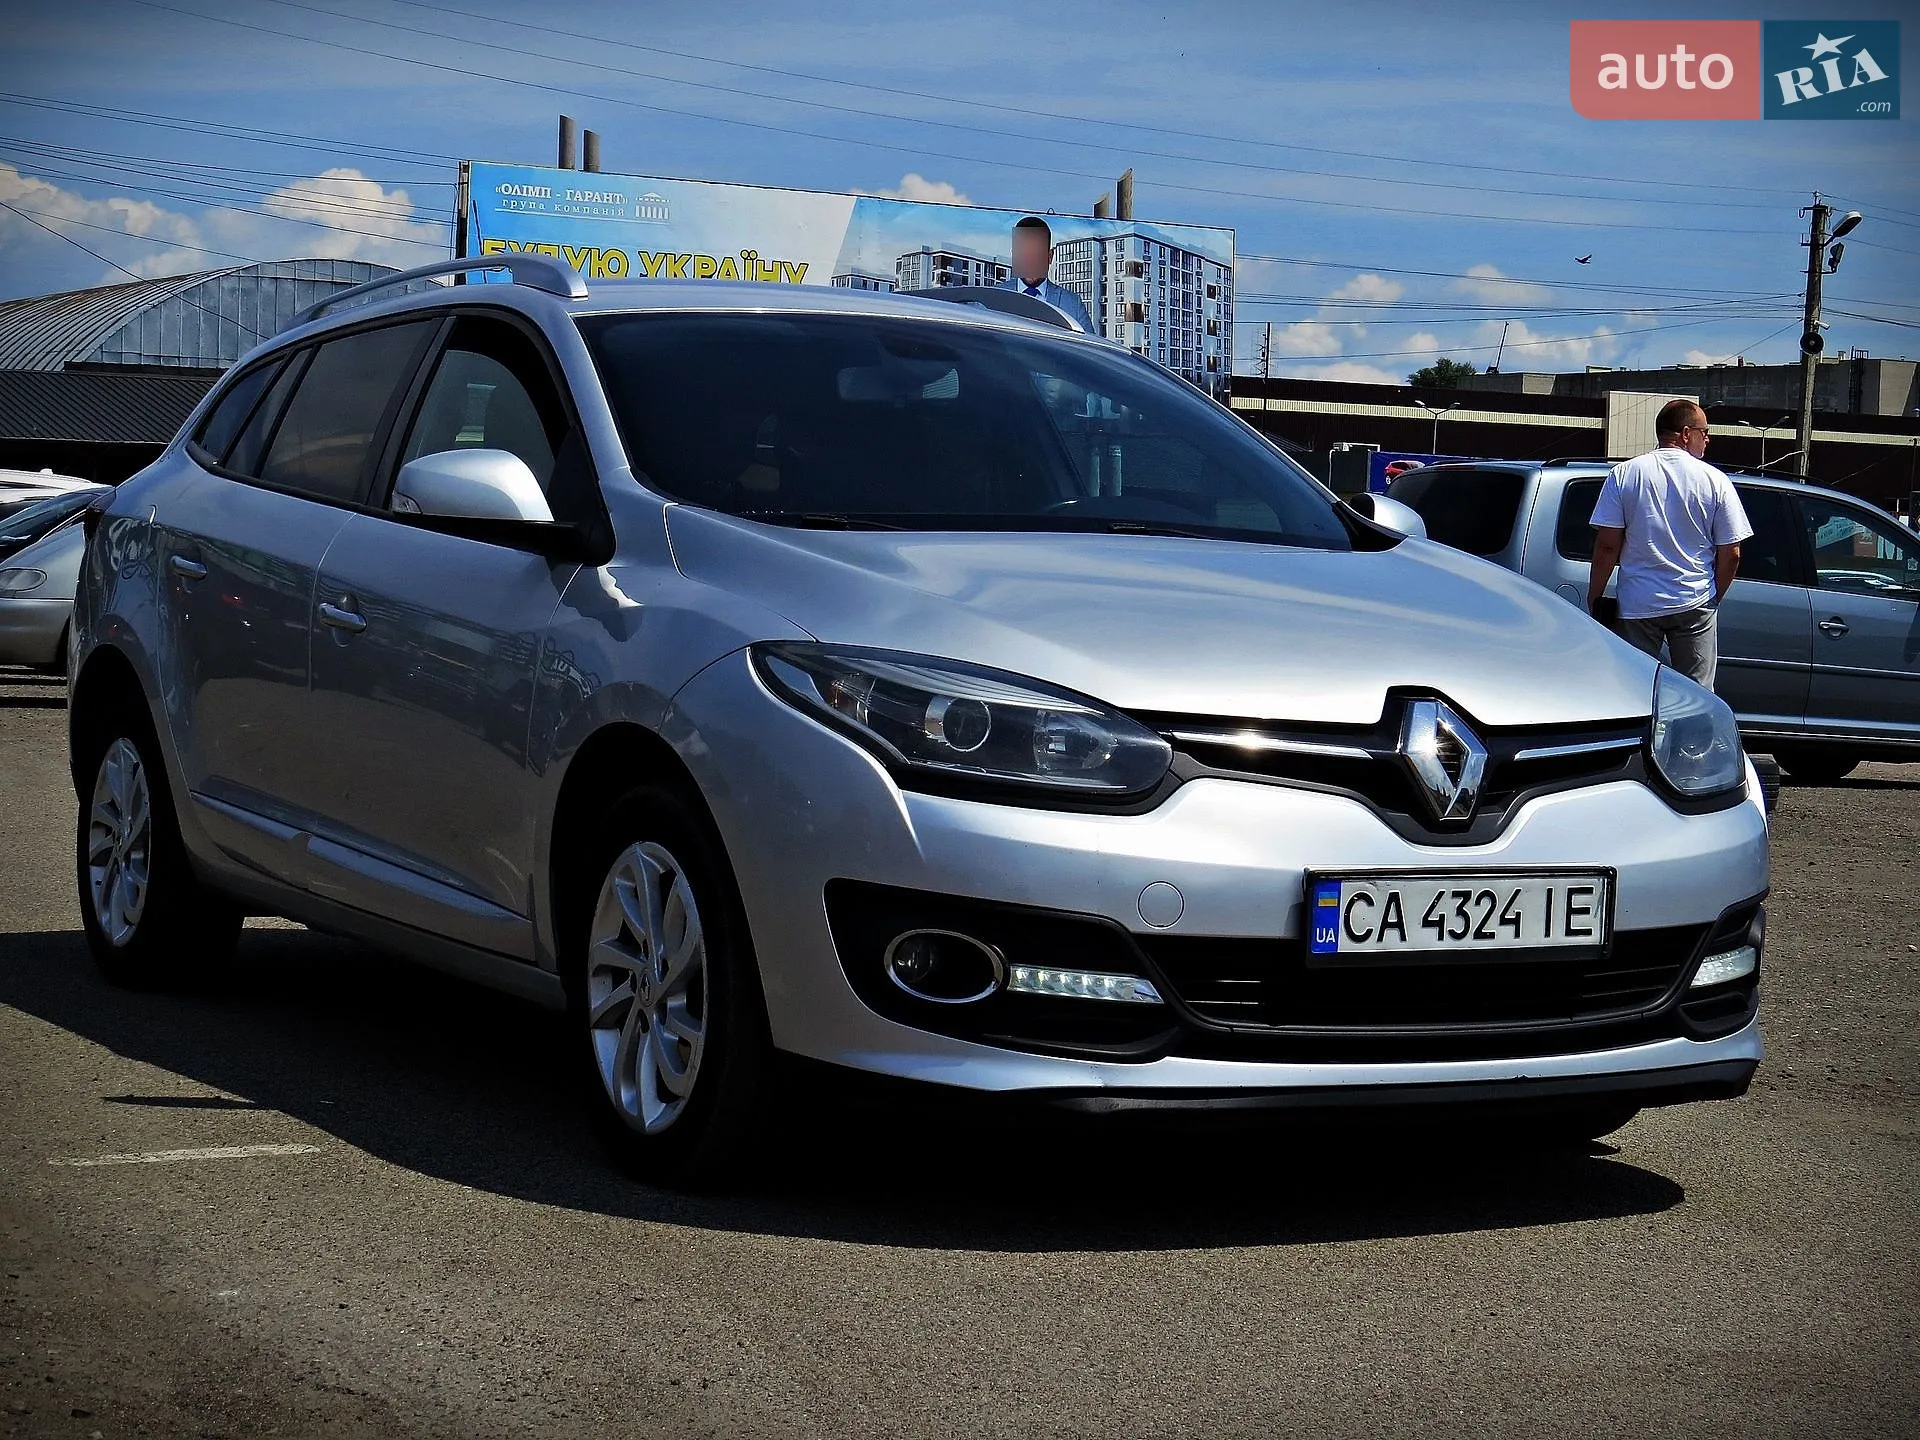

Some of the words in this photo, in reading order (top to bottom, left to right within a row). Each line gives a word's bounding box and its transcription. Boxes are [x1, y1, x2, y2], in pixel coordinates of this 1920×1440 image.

[565, 189, 628, 206] ГАРАНТ»
[502, 198, 546, 211] група
[554, 204, 625, 216] компаній
[637, 250, 809, 284] УКРАЇНУ
[1343, 891, 1407, 943] CA
[1421, 888, 1523, 941] 4324
[1544, 886, 1594, 938] IE
[1316, 928, 1335, 943] UA
